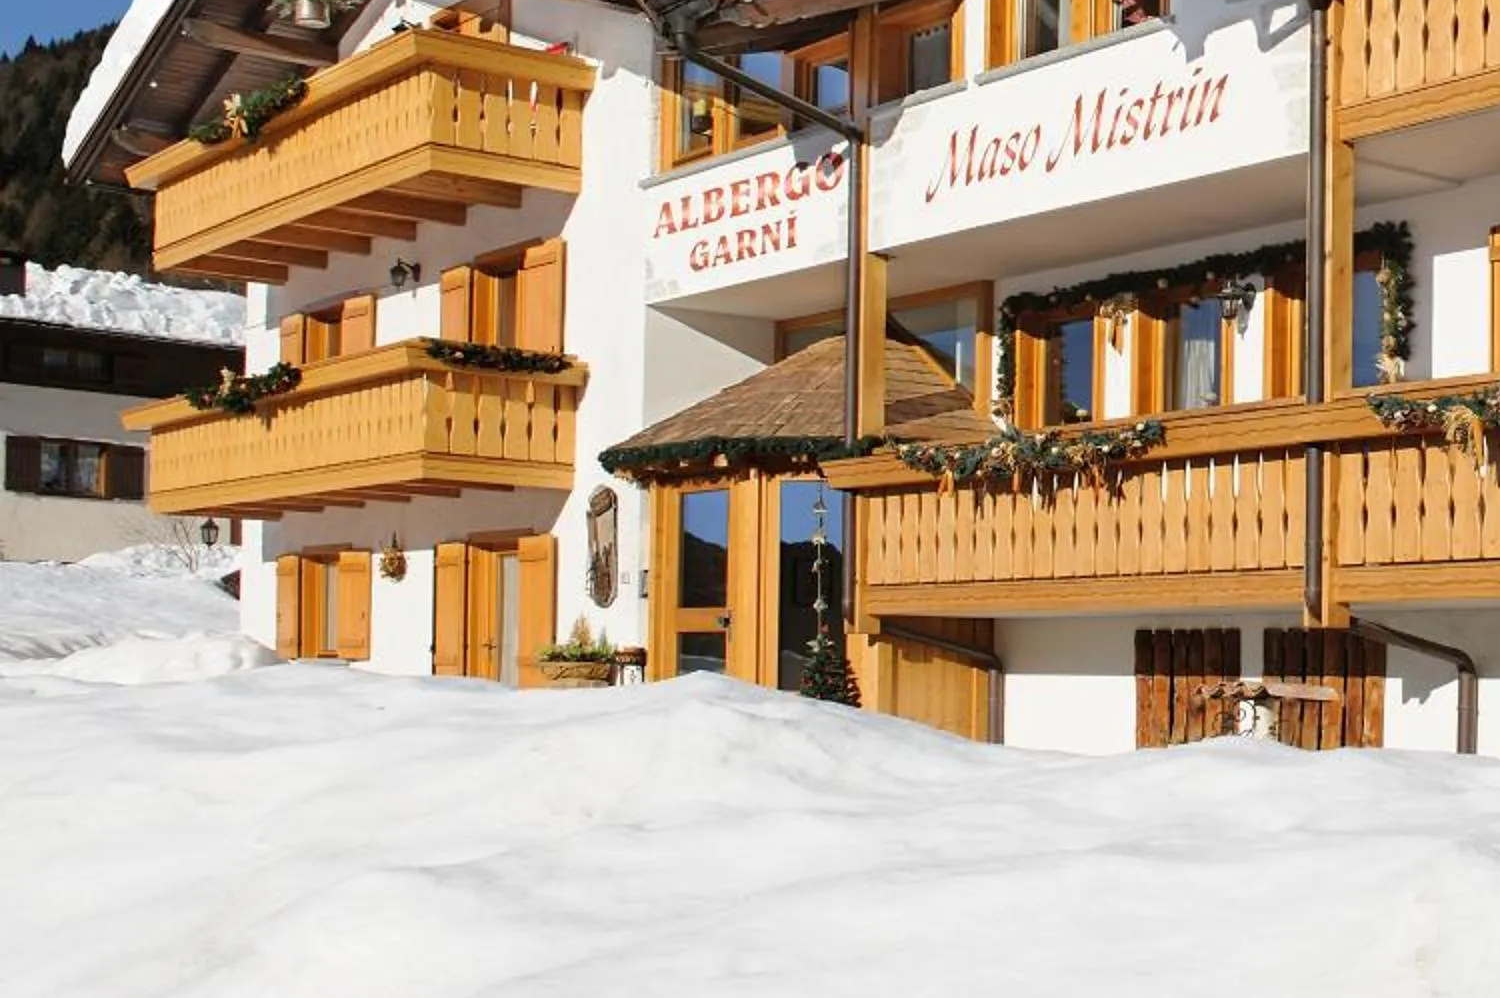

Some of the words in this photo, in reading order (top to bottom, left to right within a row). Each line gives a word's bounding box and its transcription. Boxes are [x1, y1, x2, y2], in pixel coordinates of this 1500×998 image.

[925, 124, 1041, 202] Maso
[1046, 67, 1229, 173] Mistrin
[653, 153, 845, 238] ALBERGO
